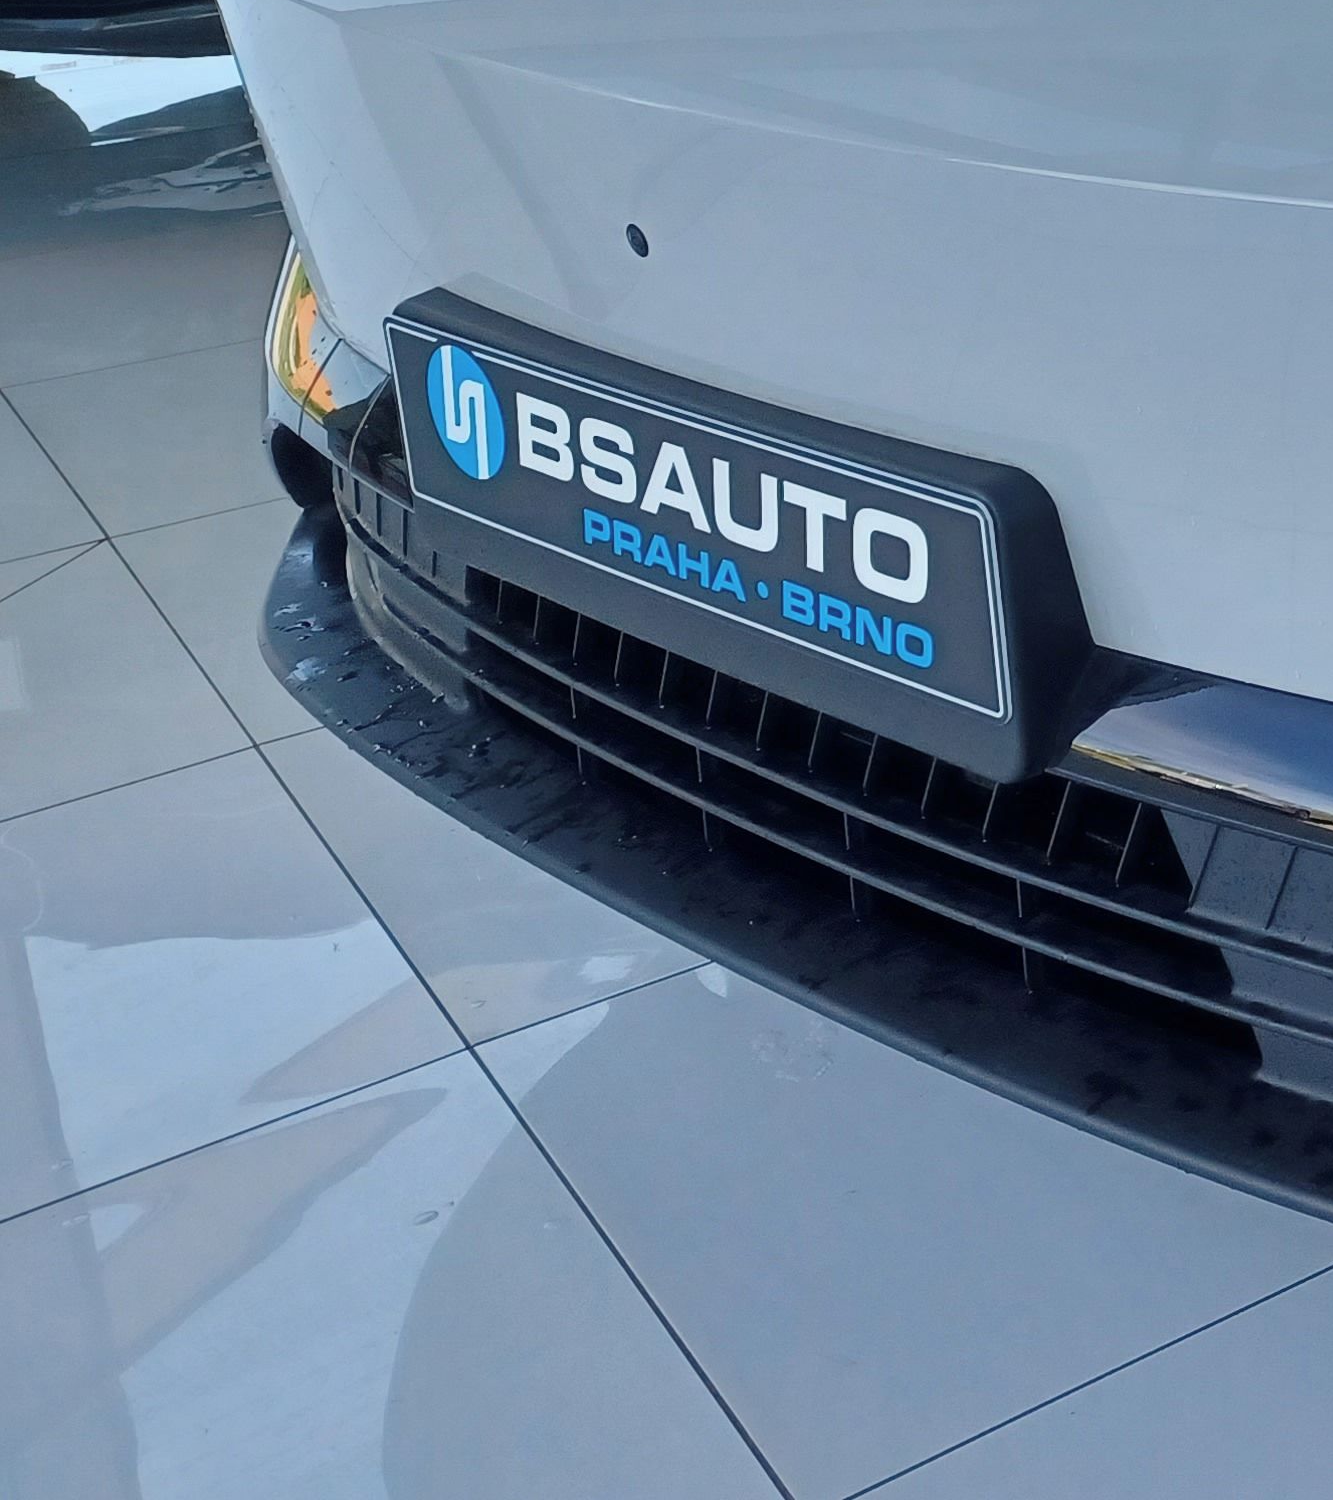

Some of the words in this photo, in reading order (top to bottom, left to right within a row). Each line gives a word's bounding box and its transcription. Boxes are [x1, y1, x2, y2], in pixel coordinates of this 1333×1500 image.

[516, 392, 928, 604] BSAUTO
[582, 507, 747, 603] PRAHA
[780, 579, 935, 669] BRNO
